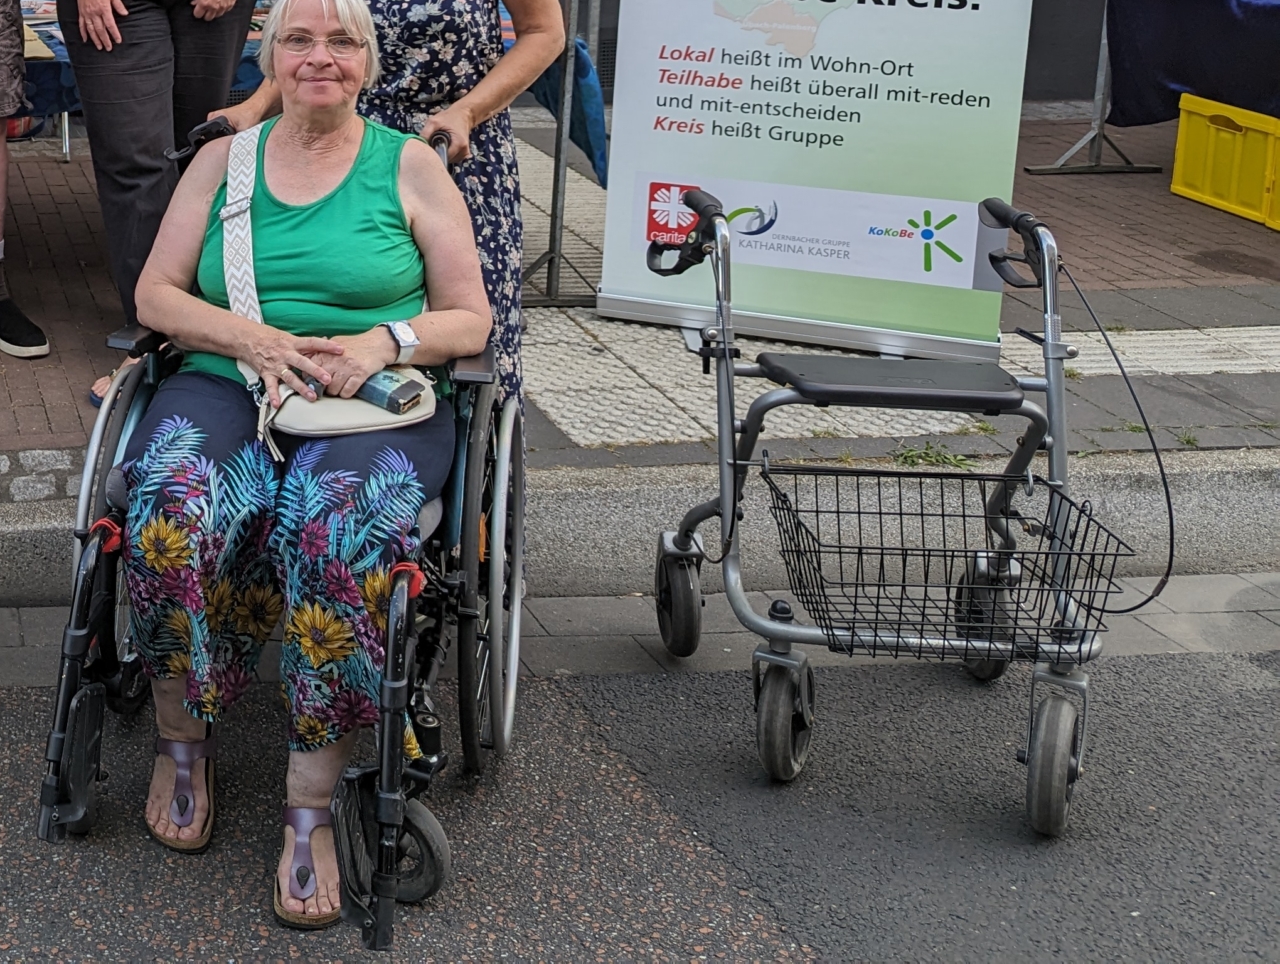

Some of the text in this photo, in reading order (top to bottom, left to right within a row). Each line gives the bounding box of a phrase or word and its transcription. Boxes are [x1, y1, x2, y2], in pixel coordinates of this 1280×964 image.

[658, 44, 915, 78] Lokal heißt im Wohn-Ort
[658, 69, 991, 109] Teilhabe heißt überall mit-reden
[656, 92, 862, 124] und mit-entscheiden
[653, 116, 844, 148] Kreis heißt Gruppe
[650, 230, 688, 244] carita
[772, 233, 851, 248] DERNBACHER GRUPPE
[868, 225, 914, 240] KoKoBe
[738, 239, 851, 260] KATHARINA KASPER
